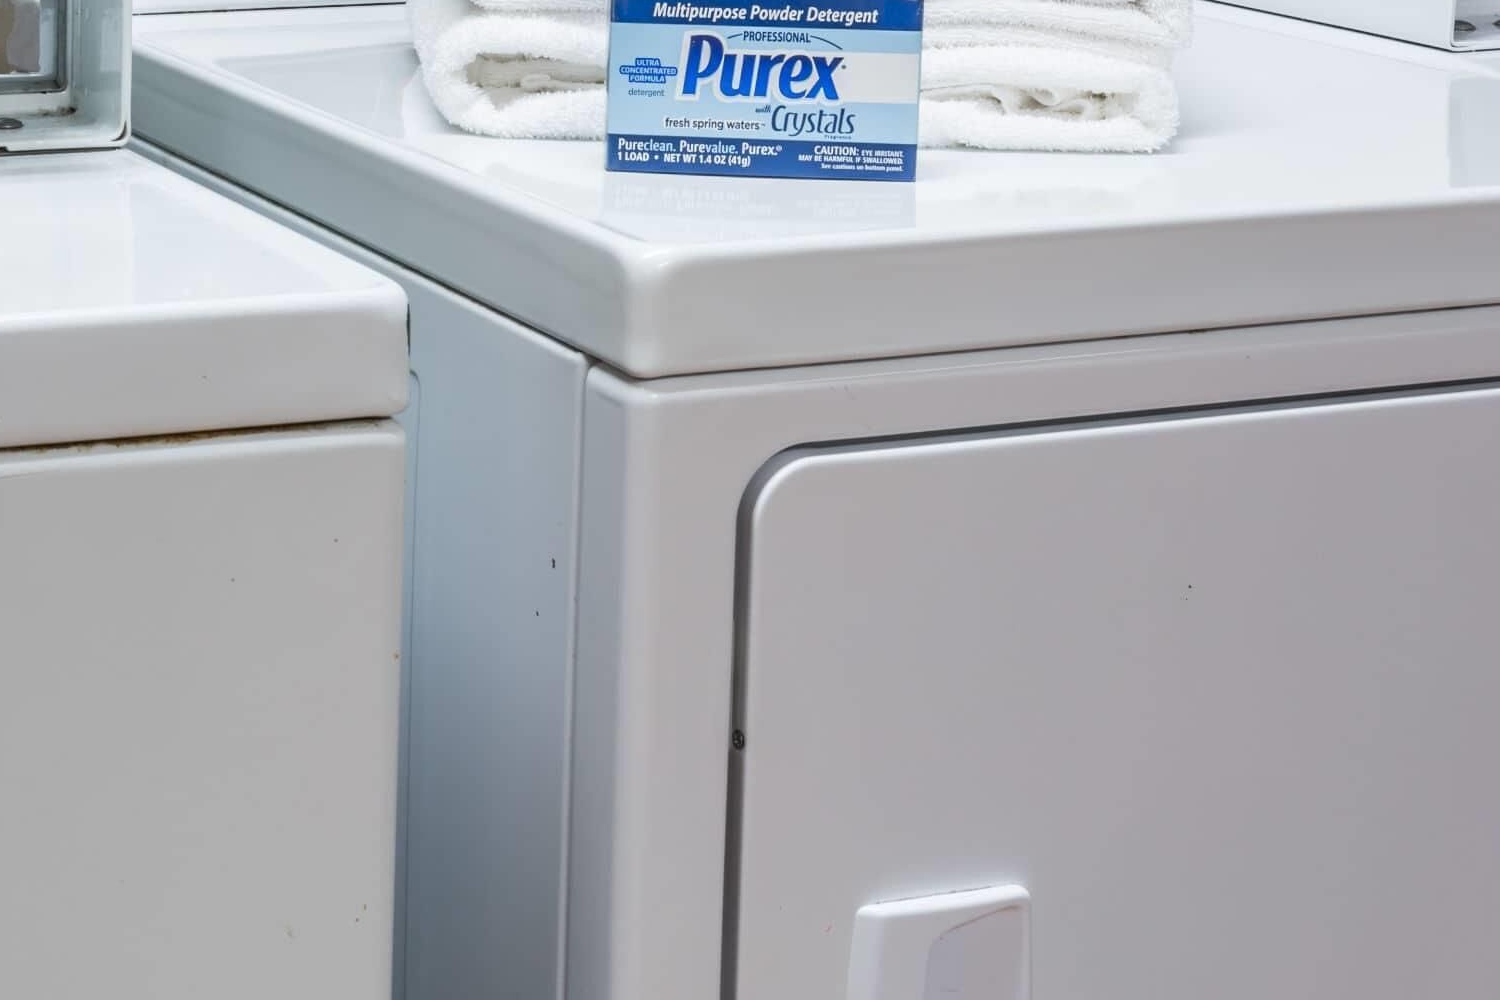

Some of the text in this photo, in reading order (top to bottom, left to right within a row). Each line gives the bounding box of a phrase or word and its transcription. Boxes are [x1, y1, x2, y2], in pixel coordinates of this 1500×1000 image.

[653, 2, 879, 26] Multipurpose Powder Detergent
[743, 31, 811, 43] PROFESSIONAL
[620, 66, 676, 75] CONCENTRATED
[682, 35, 844, 100] Purex
[628, 88, 665, 97] detergent
[665, 117, 690, 128] fresh
[692, 118, 724, 131] spring
[772, 105, 856, 137] Crystals
[618, 138, 676, 152] Pureclean.
[679, 140, 738, 154] Purevalue.
[814, 146, 860, 156] CAUTION:
[618, 152, 751, 167] 1 LOAD NET WT 1.4 OZ (41g)
[823, 155, 853, 163] HARMFUL
